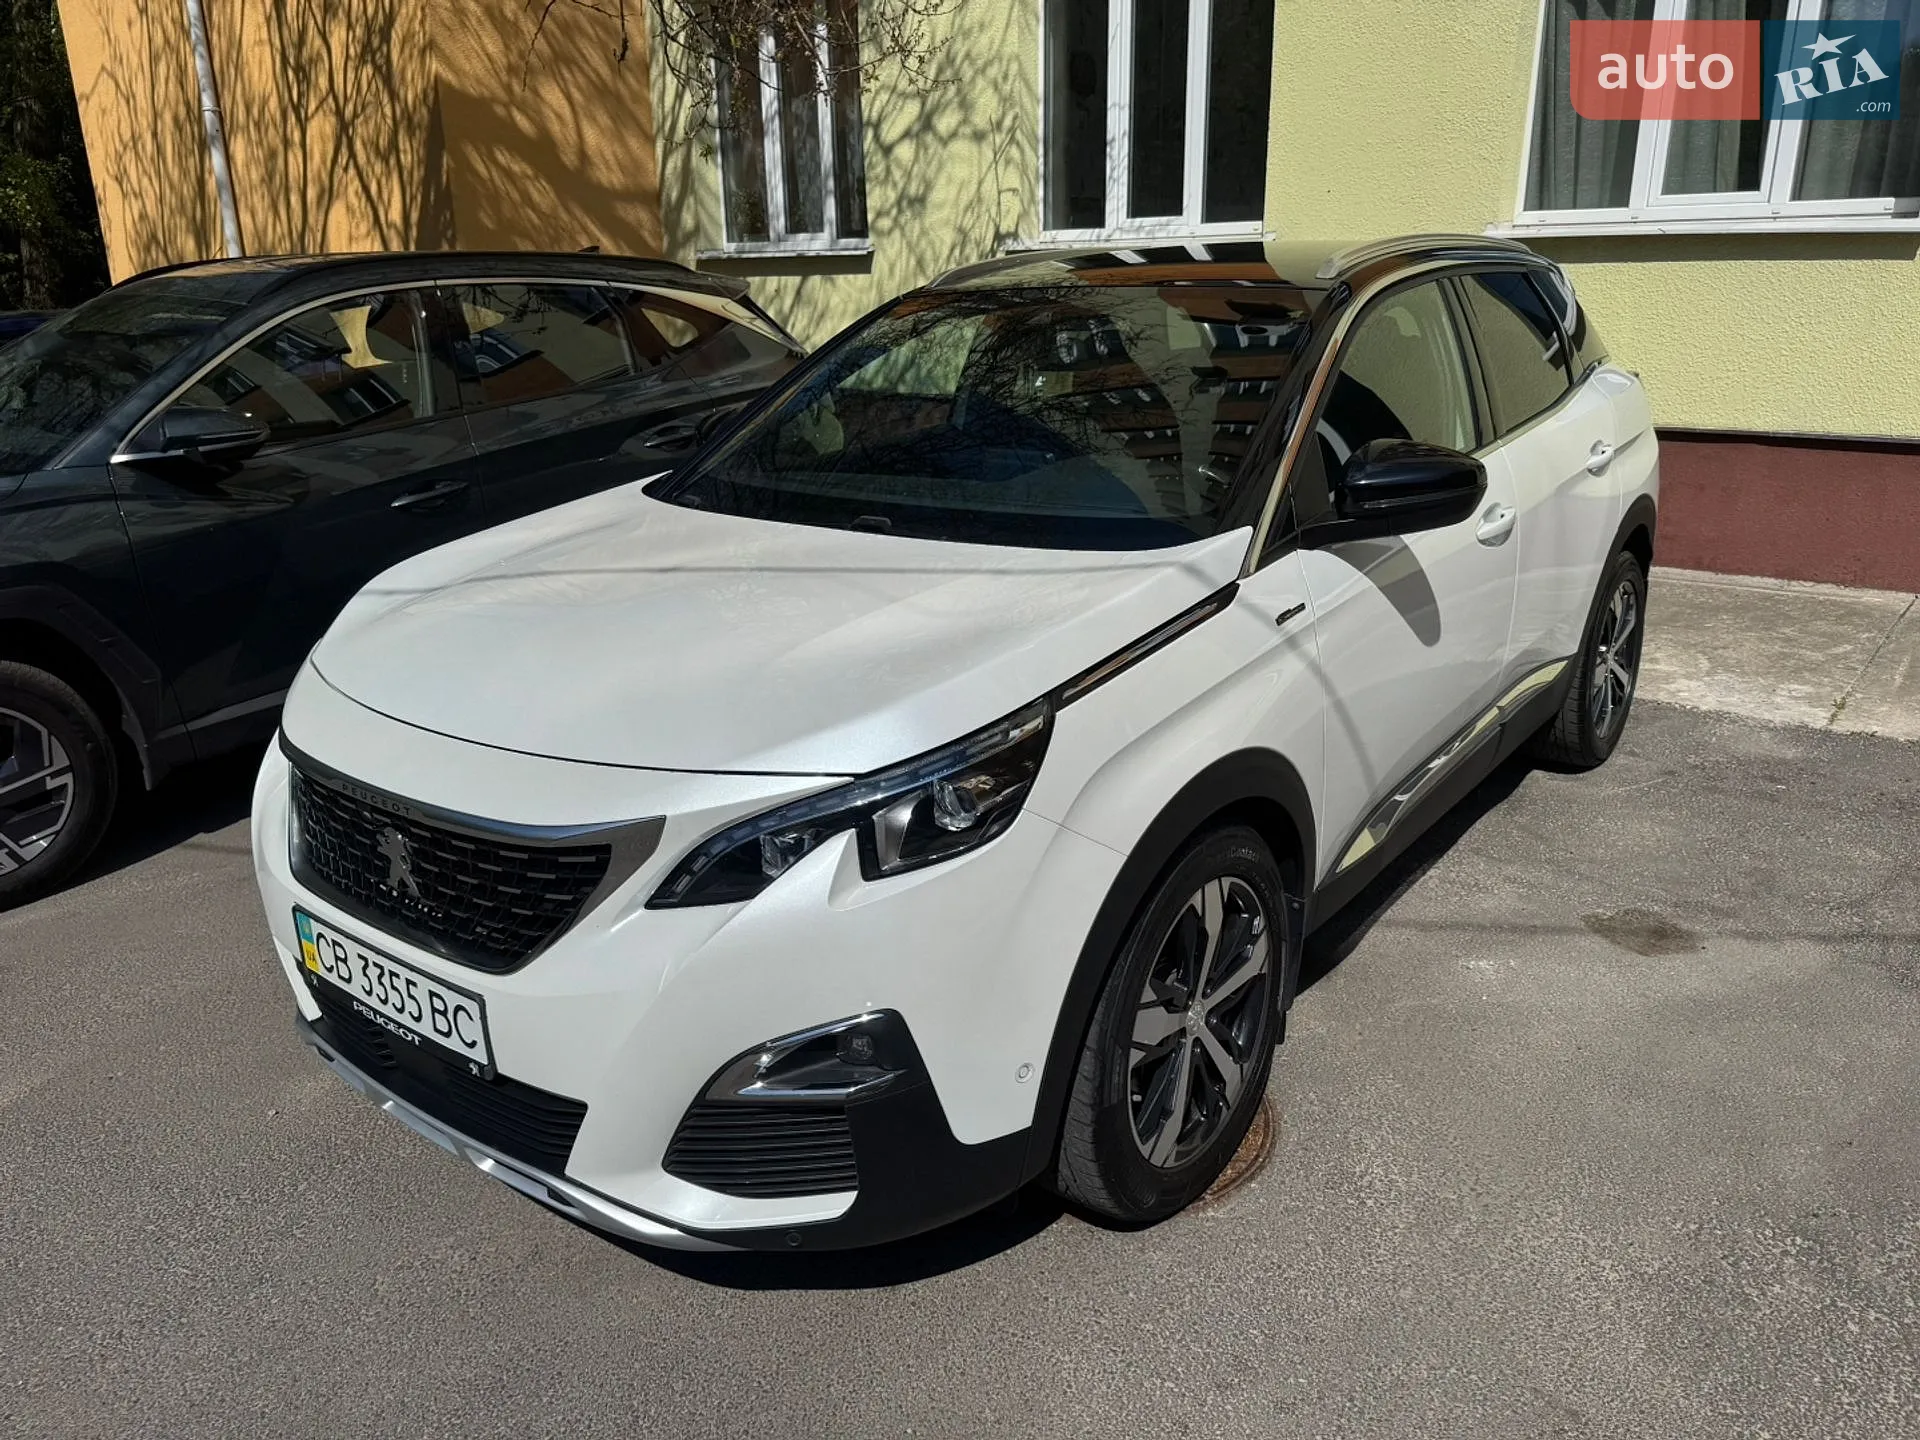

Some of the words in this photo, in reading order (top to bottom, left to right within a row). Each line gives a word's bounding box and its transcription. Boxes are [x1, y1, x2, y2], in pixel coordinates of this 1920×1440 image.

[342, 783, 410, 816] PEUGEOT
[316, 931, 353, 985] CB
[357, 952, 423, 1023] 3355
[428, 989, 478, 1049] BC
[353, 1001, 422, 1046] PEUGEOT
